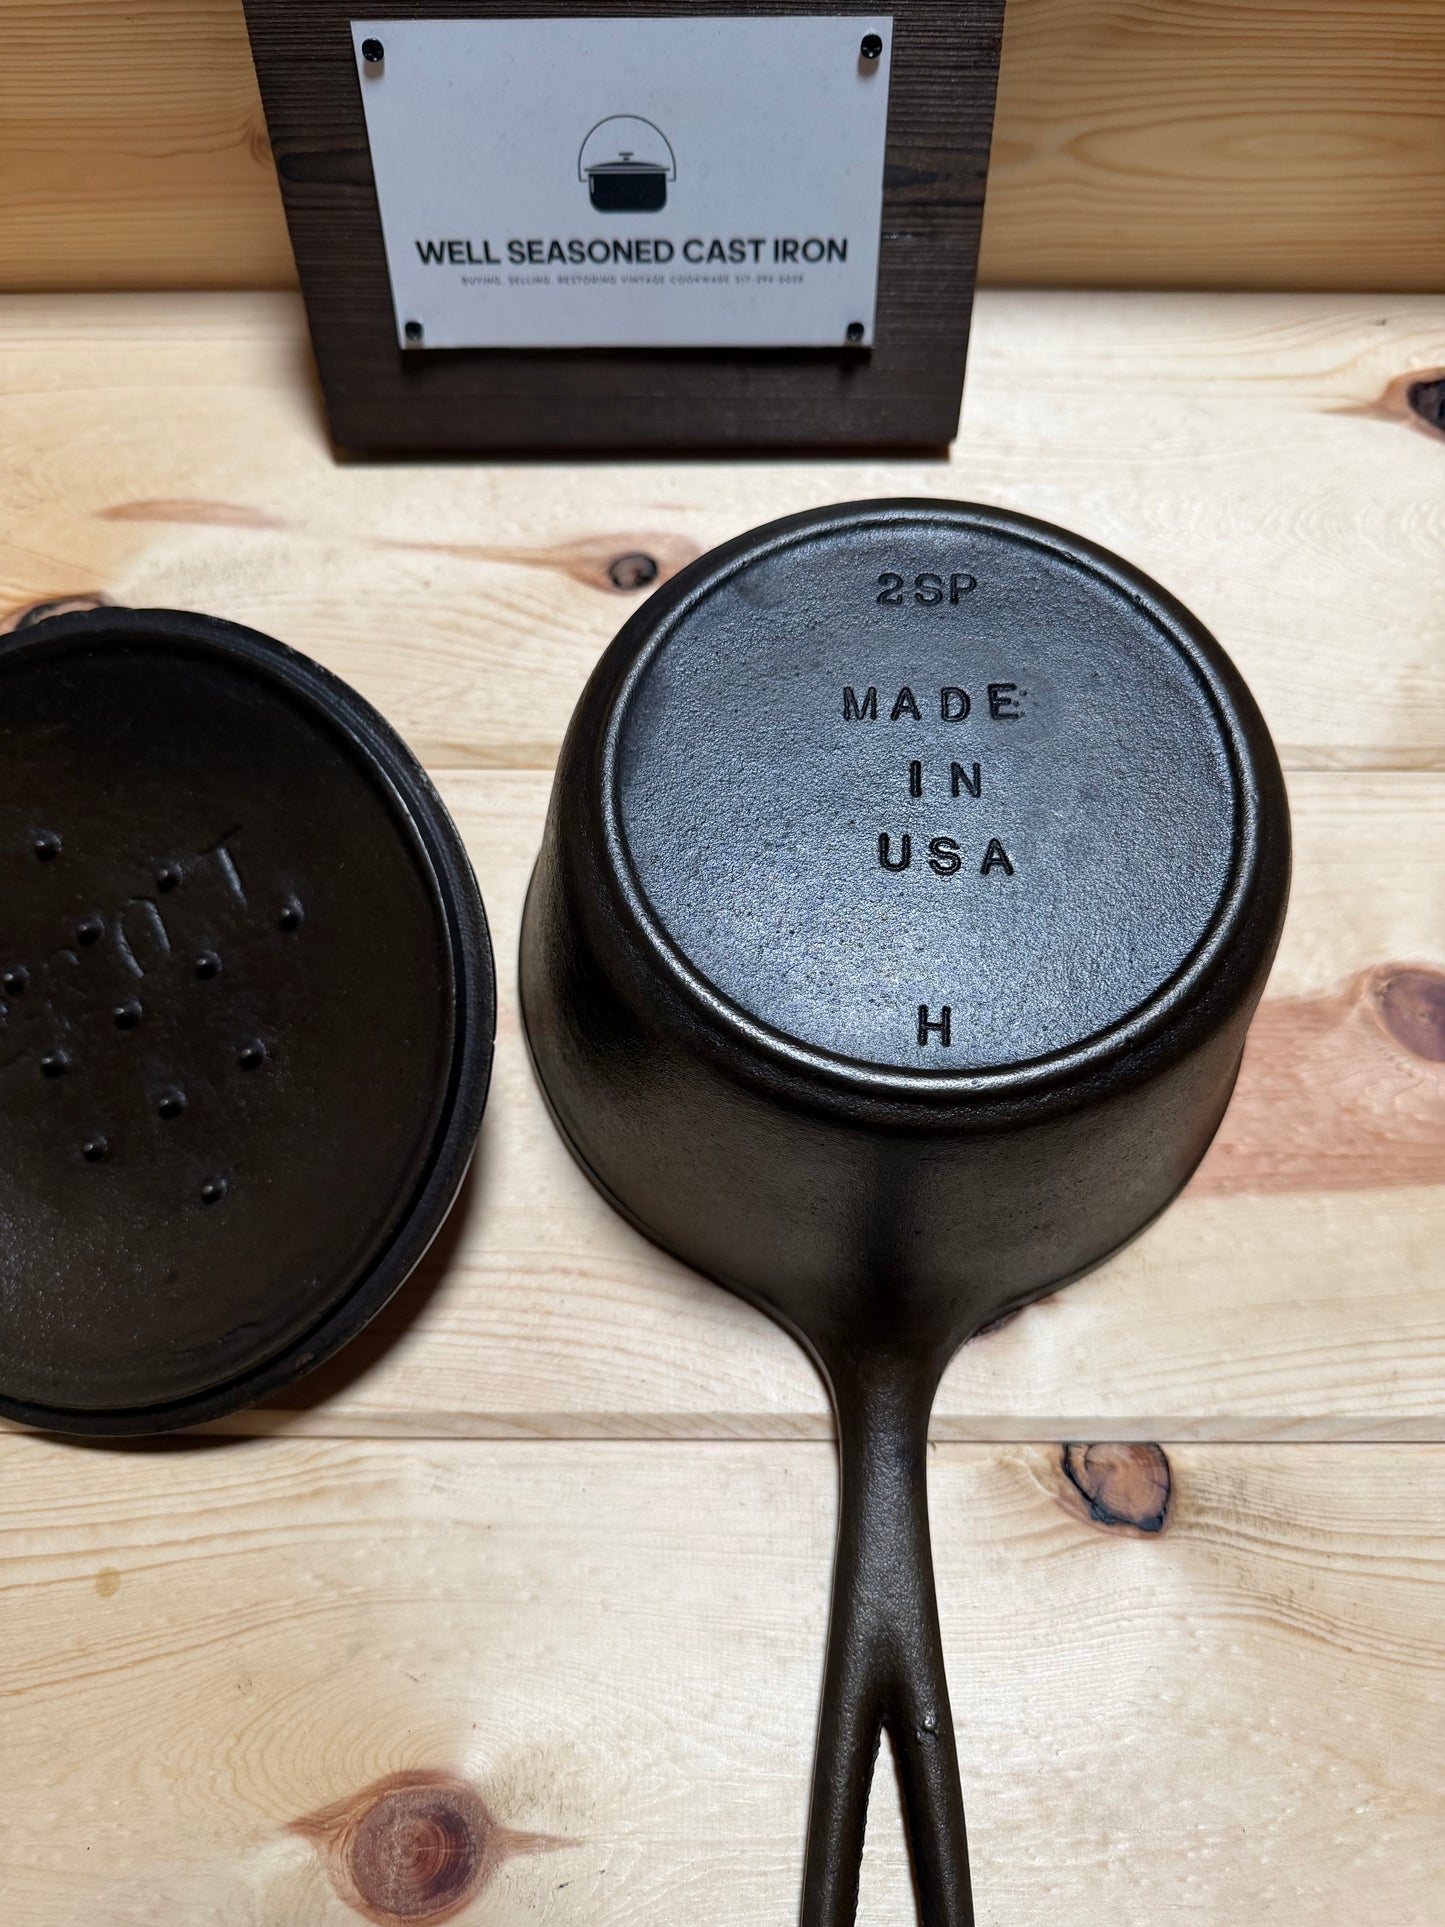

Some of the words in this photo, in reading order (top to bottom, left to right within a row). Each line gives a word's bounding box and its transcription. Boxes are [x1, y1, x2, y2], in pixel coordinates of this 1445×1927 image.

[416, 240, 502, 265] WELL
[507, 239, 675, 265] SEASONED
[682, 238, 766, 264] CAST
[773, 238, 848, 264] IRON
[619, 274, 665, 285] VINTAGE
[669, 274, 730, 285] COOKWARE
[877, 572, 978, 606] 2SP
[843, 682, 1021, 722] MADE
[908, 759, 982, 799] IN
[877, 831, 1016, 877] USA
[917, 1004, 953, 1048] H
